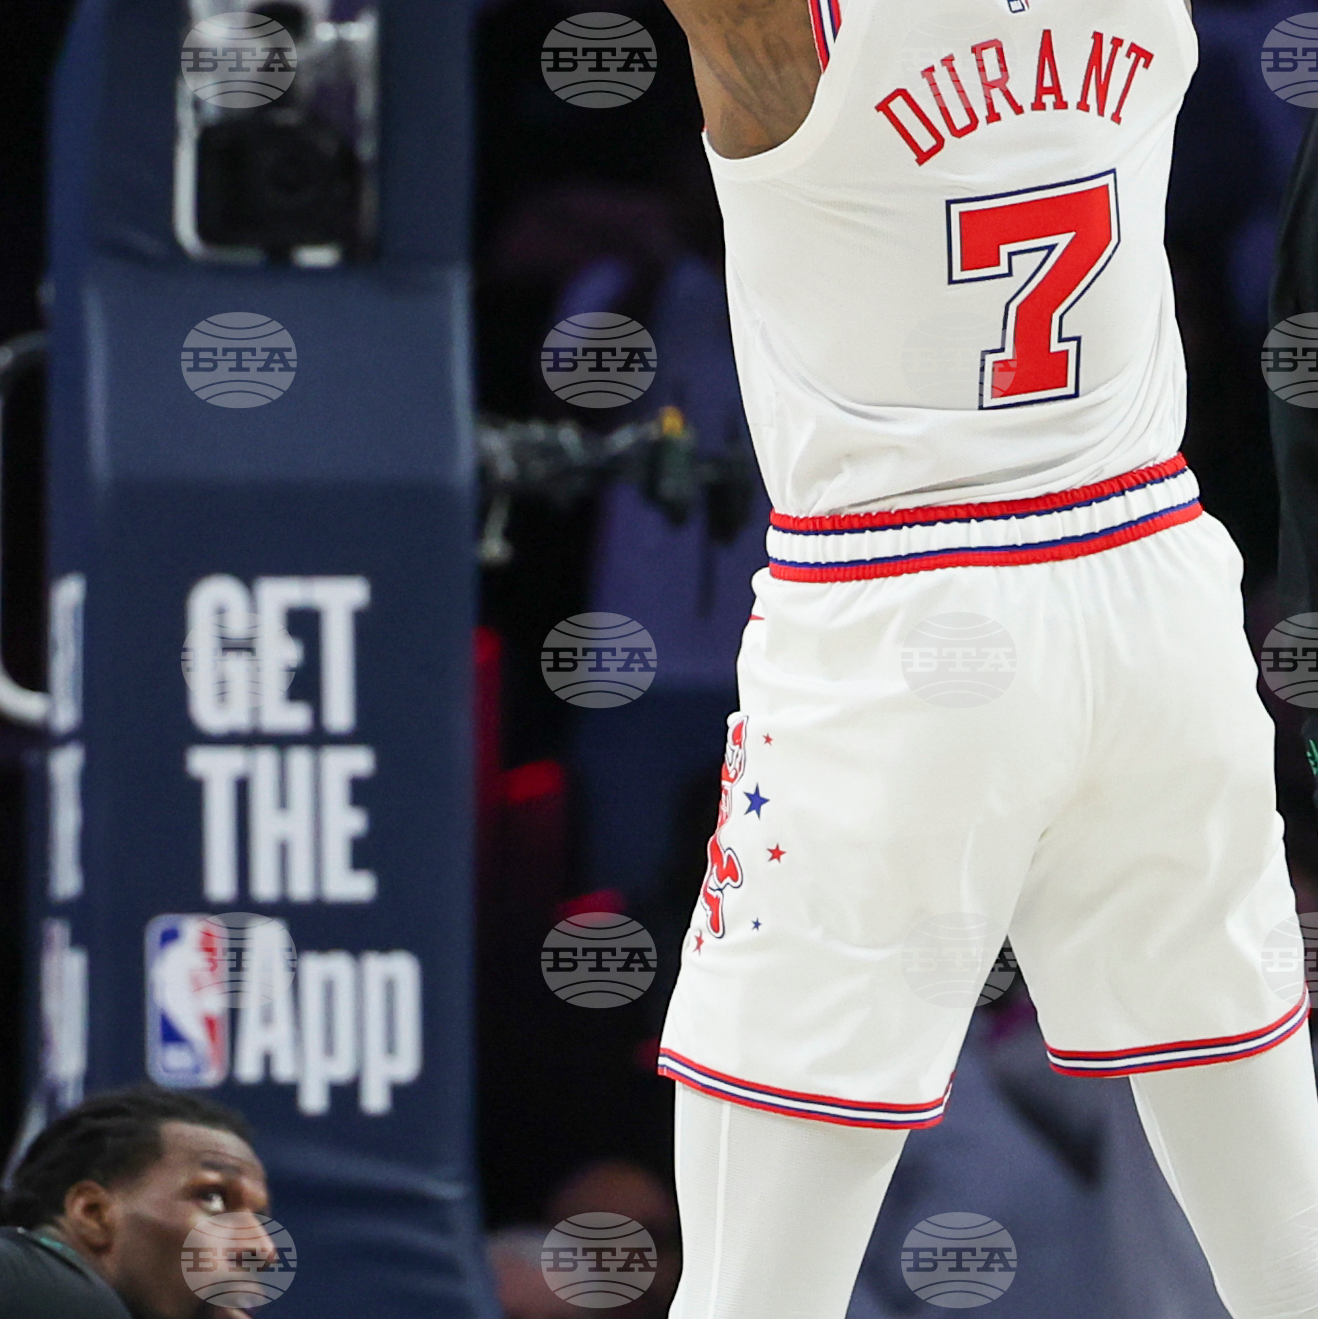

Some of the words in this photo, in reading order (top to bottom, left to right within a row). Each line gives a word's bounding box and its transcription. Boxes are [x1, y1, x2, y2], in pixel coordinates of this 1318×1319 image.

[875, 29, 1154, 166] DURANT
[945, 168, 1121, 410] 7
[186, 575, 371, 734] GET
[185, 745, 377, 903] THE
[234, 917, 421, 1114] App
